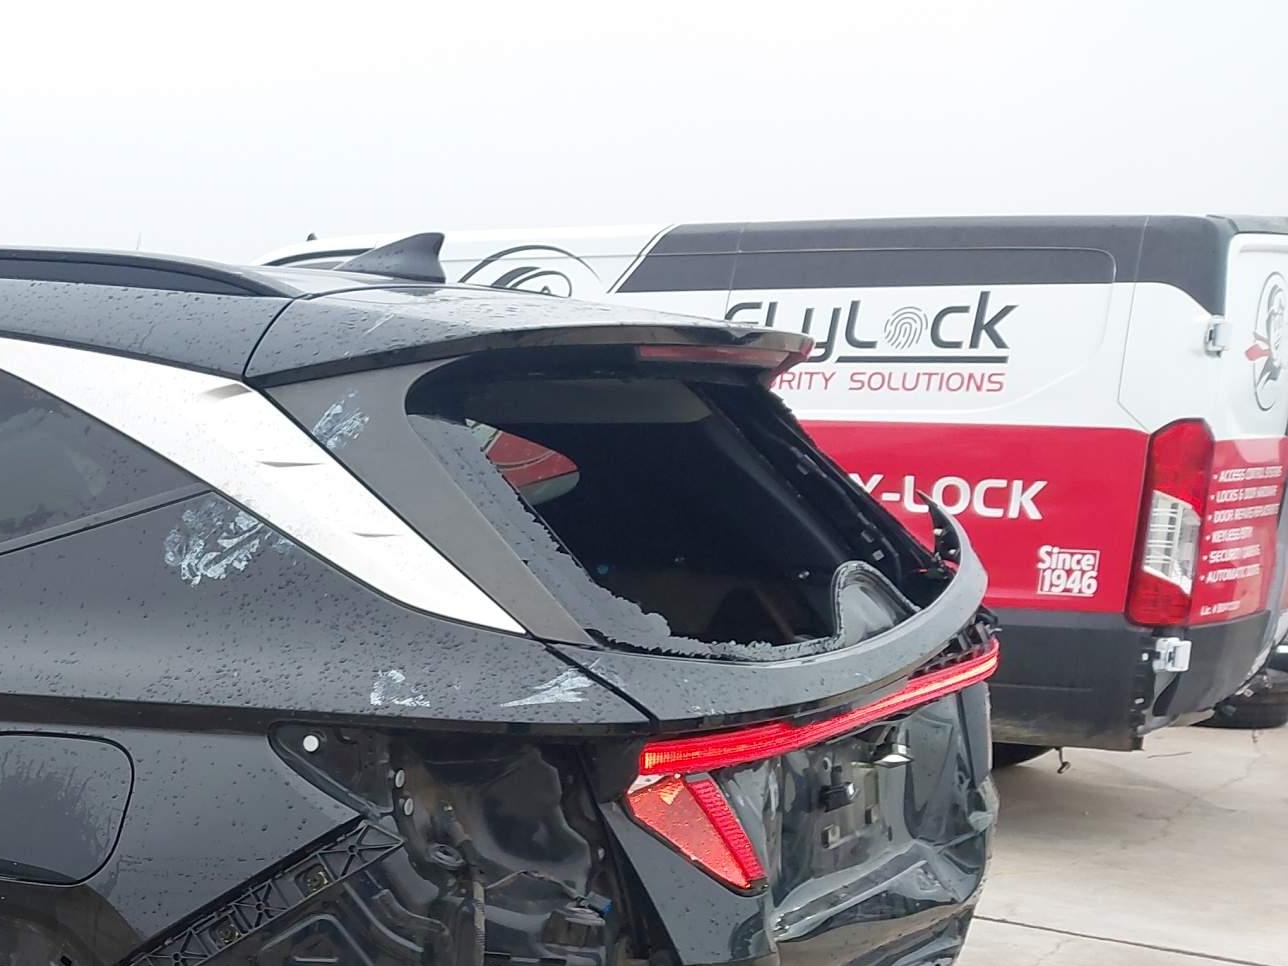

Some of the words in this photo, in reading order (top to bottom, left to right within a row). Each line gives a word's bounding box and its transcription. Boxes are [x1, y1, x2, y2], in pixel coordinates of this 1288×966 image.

[848, 371, 1006, 392] SOLUTIONS
[1037, 544, 1095, 570] Since
[1042, 568, 1098, 594] 1946
